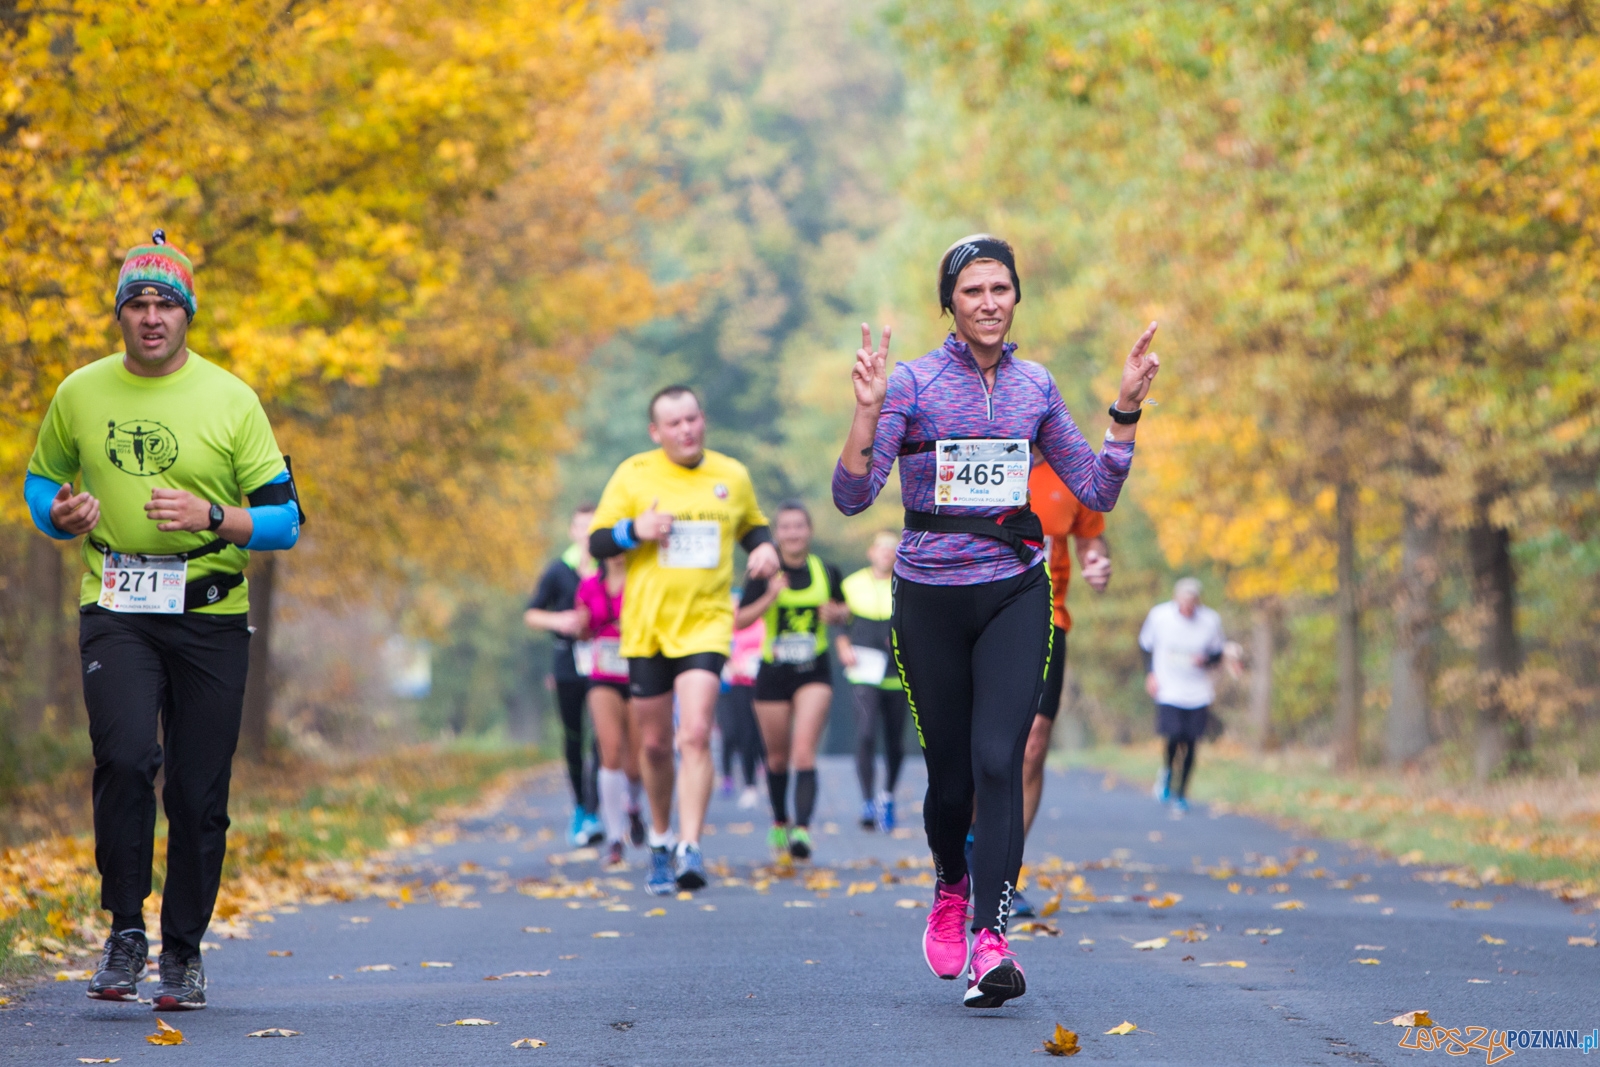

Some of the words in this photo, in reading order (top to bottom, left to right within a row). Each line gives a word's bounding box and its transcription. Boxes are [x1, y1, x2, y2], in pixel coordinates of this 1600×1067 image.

[956, 463, 1005, 486] 465
[118, 570, 158, 593] 271
[891, 626, 927, 750] RUNNING
